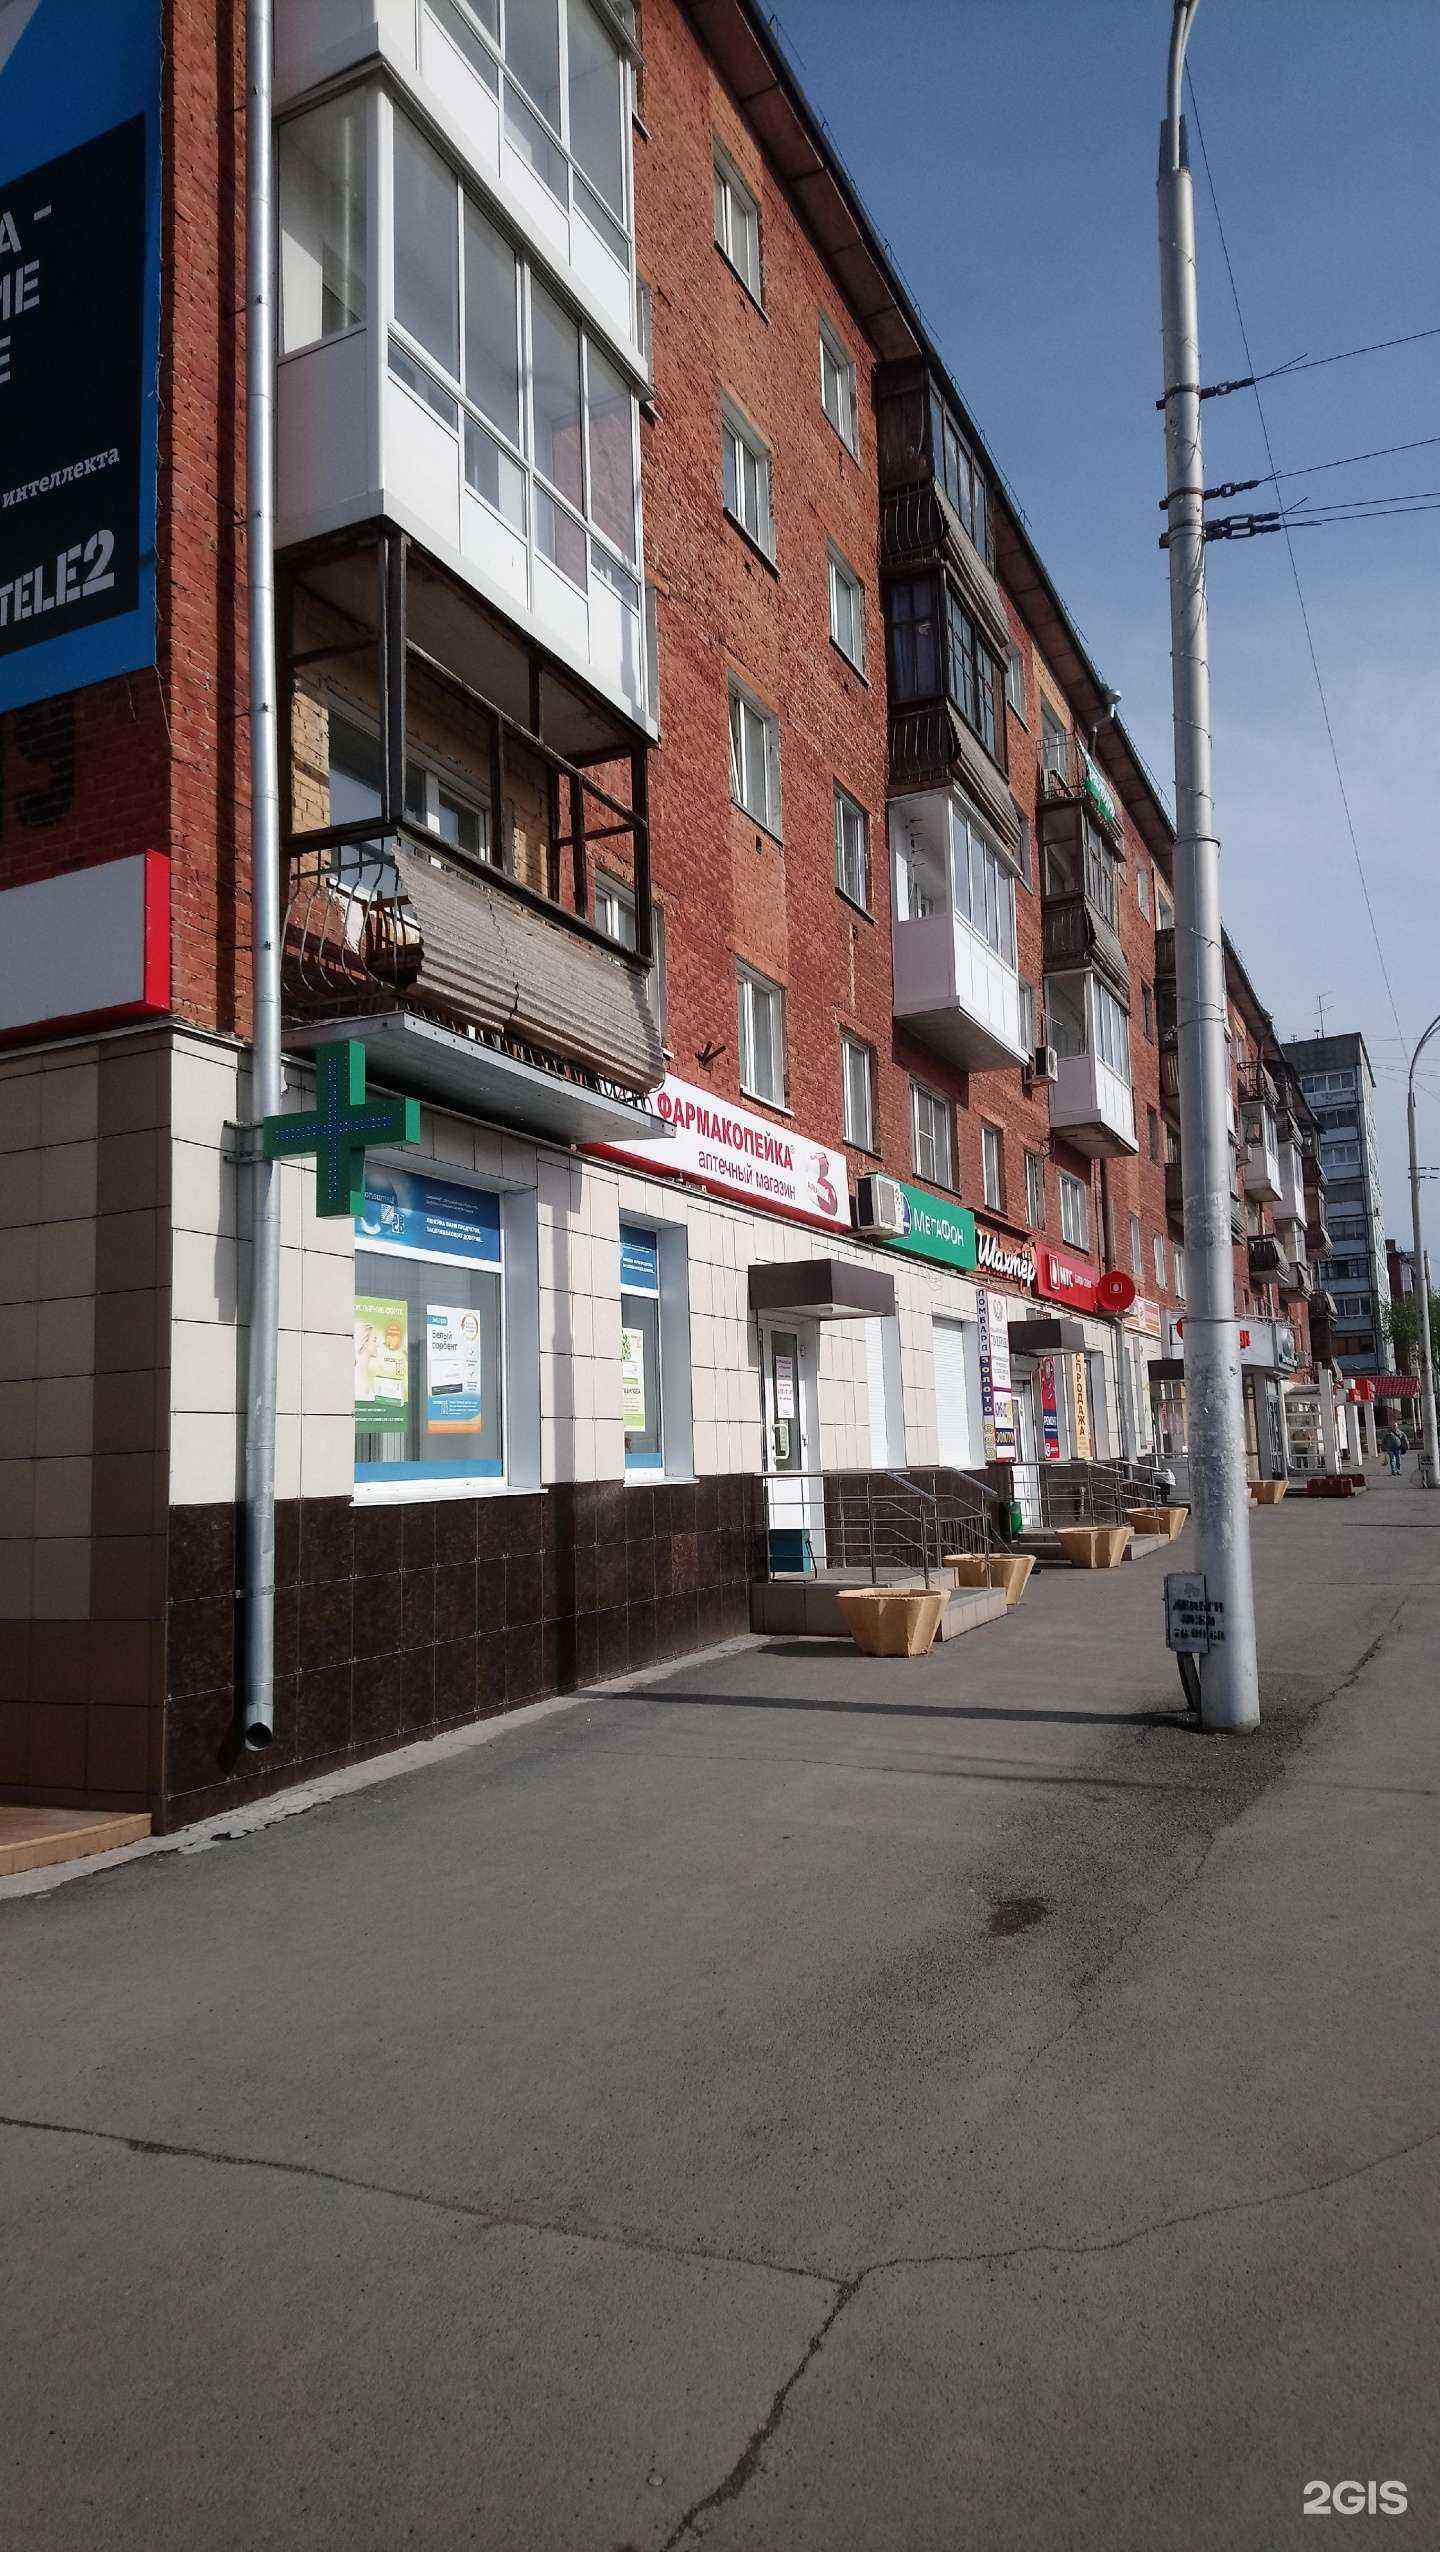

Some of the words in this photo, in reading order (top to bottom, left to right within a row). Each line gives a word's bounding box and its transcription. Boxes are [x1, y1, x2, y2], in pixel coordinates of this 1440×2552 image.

[2, 447, 120, 509] интеллекта
[0, 529, 115, 627] TELE2
[657, 1092, 794, 1172] ФАРМАКОПЕЙКА
[698, 1149, 754, 1185] аптечный
[756, 1172, 797, 1201] магазин
[977, 1230, 1037, 1288] Шахтёр
[432, 1328, 454, 1340] Белый
[432, 1340, 458, 1351] сорбент
[980, 1356, 993, 1413] ЗОЛОТО
